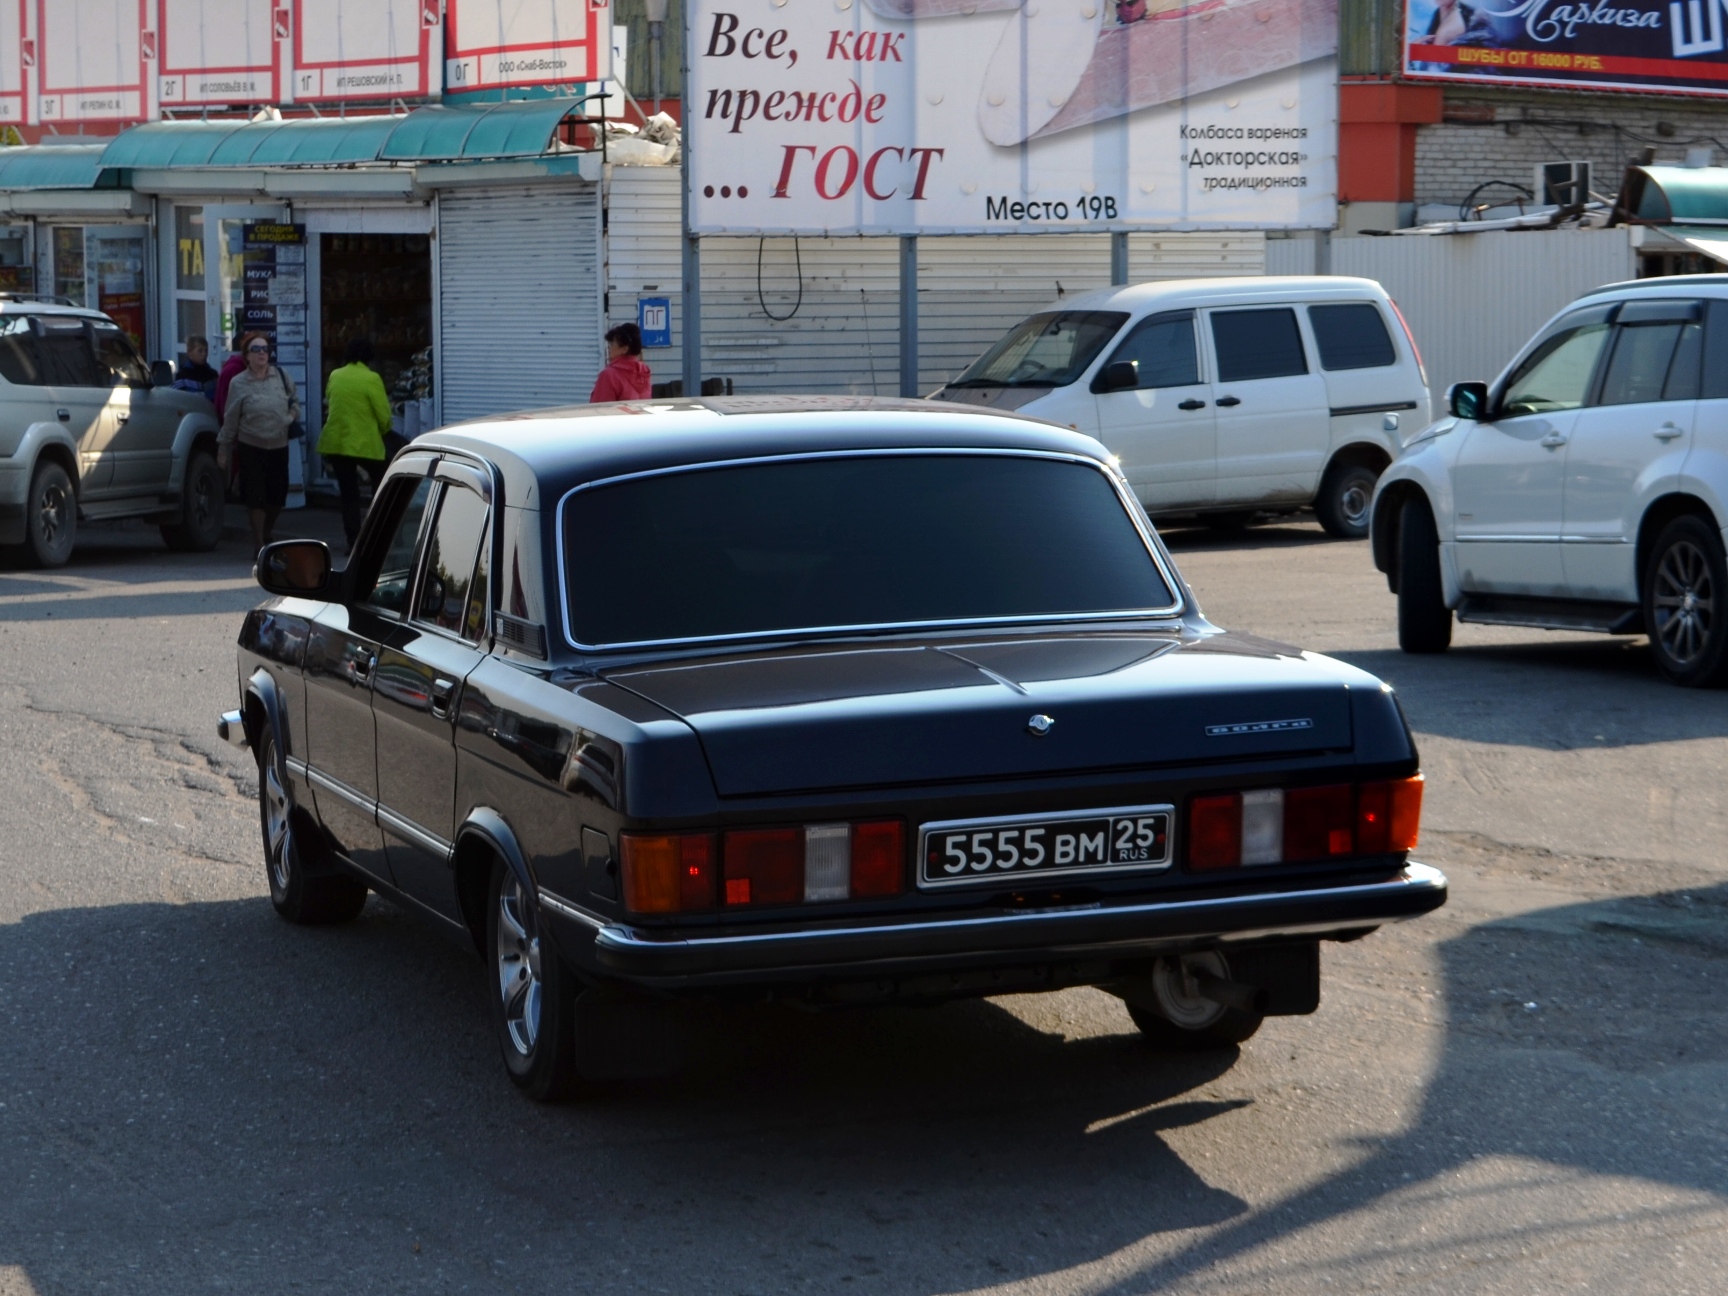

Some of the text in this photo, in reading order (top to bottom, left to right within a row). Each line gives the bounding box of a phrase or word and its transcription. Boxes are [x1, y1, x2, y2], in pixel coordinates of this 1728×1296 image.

[702, 12, 905, 69] Все, как
[1458, 47, 1604, 70] ШУБЫ ОТ 16000 РУБ.
[499, 61, 515, 73] ООО
[301, 75, 312, 91] 1Г
[347, 73, 388, 87] РЕШОВСКИЙ
[165, 81, 176, 96] 2Г
[704, 78, 887, 134] прежде
[1180, 124, 1244, 140] Колбаса
[1180, 148, 1308, 169] «Докторская»
[769, 145, 945, 201] ГОСТ
[1203, 175, 1307, 190] традиционная
[986, 195, 1118, 220] Место 19В
[254, 225, 294, 234] СЕГОДНЯ
[256, 233, 300, 243] ПРОДАЖЕ
[247, 310, 274, 319] СОЛЬ
[943, 818, 1155, 874] 5555 ВМ 25
[1119, 848, 1148, 861] RUS
